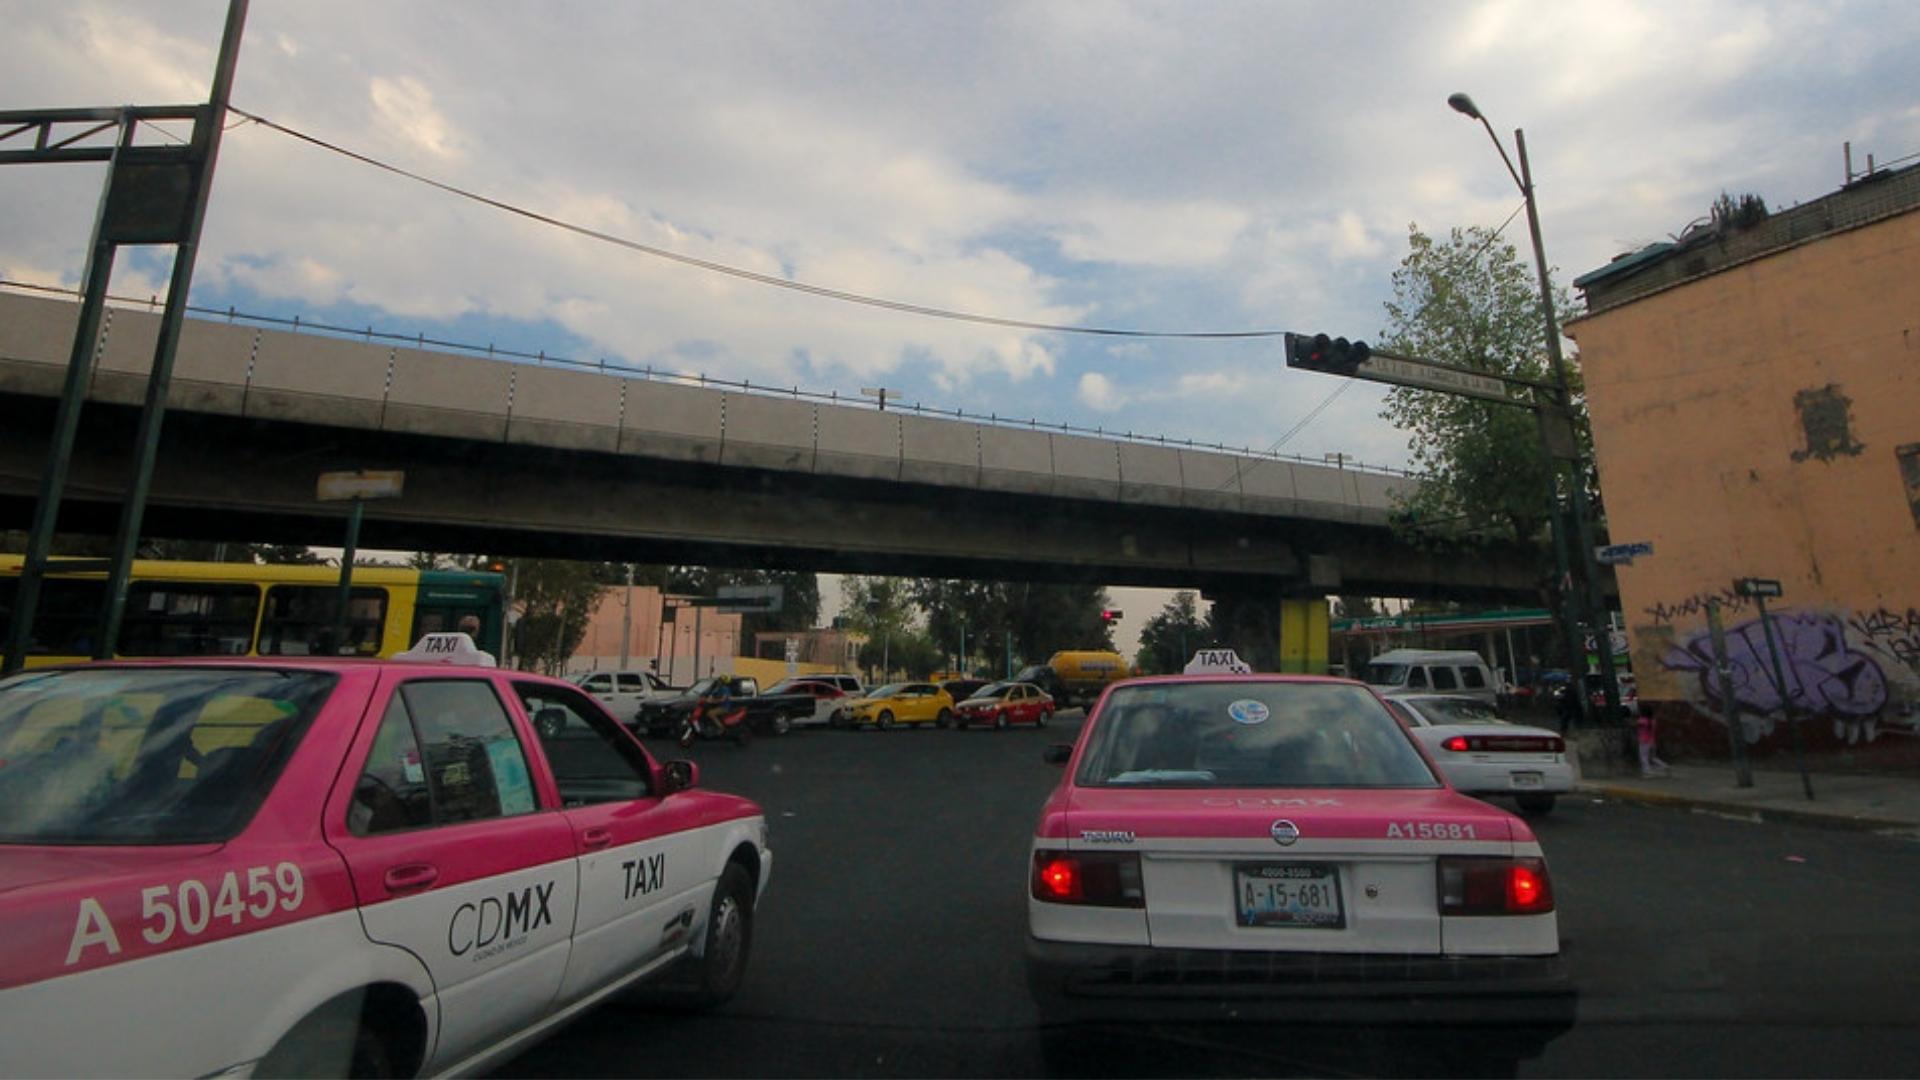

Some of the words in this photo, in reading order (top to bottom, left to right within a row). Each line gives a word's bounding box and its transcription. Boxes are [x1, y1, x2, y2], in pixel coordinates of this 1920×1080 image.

[425, 637, 458, 653] TAXI
[1199, 651, 1234, 667] TAXI
[1387, 822, 1476, 839] A15681
[622, 853, 664, 899] TAXI
[1246, 883, 1331, 908] A-15-681
[65, 899, 122, 966] A
[141, 863, 304, 944] 50459
[449, 881, 555, 957] CDMX
